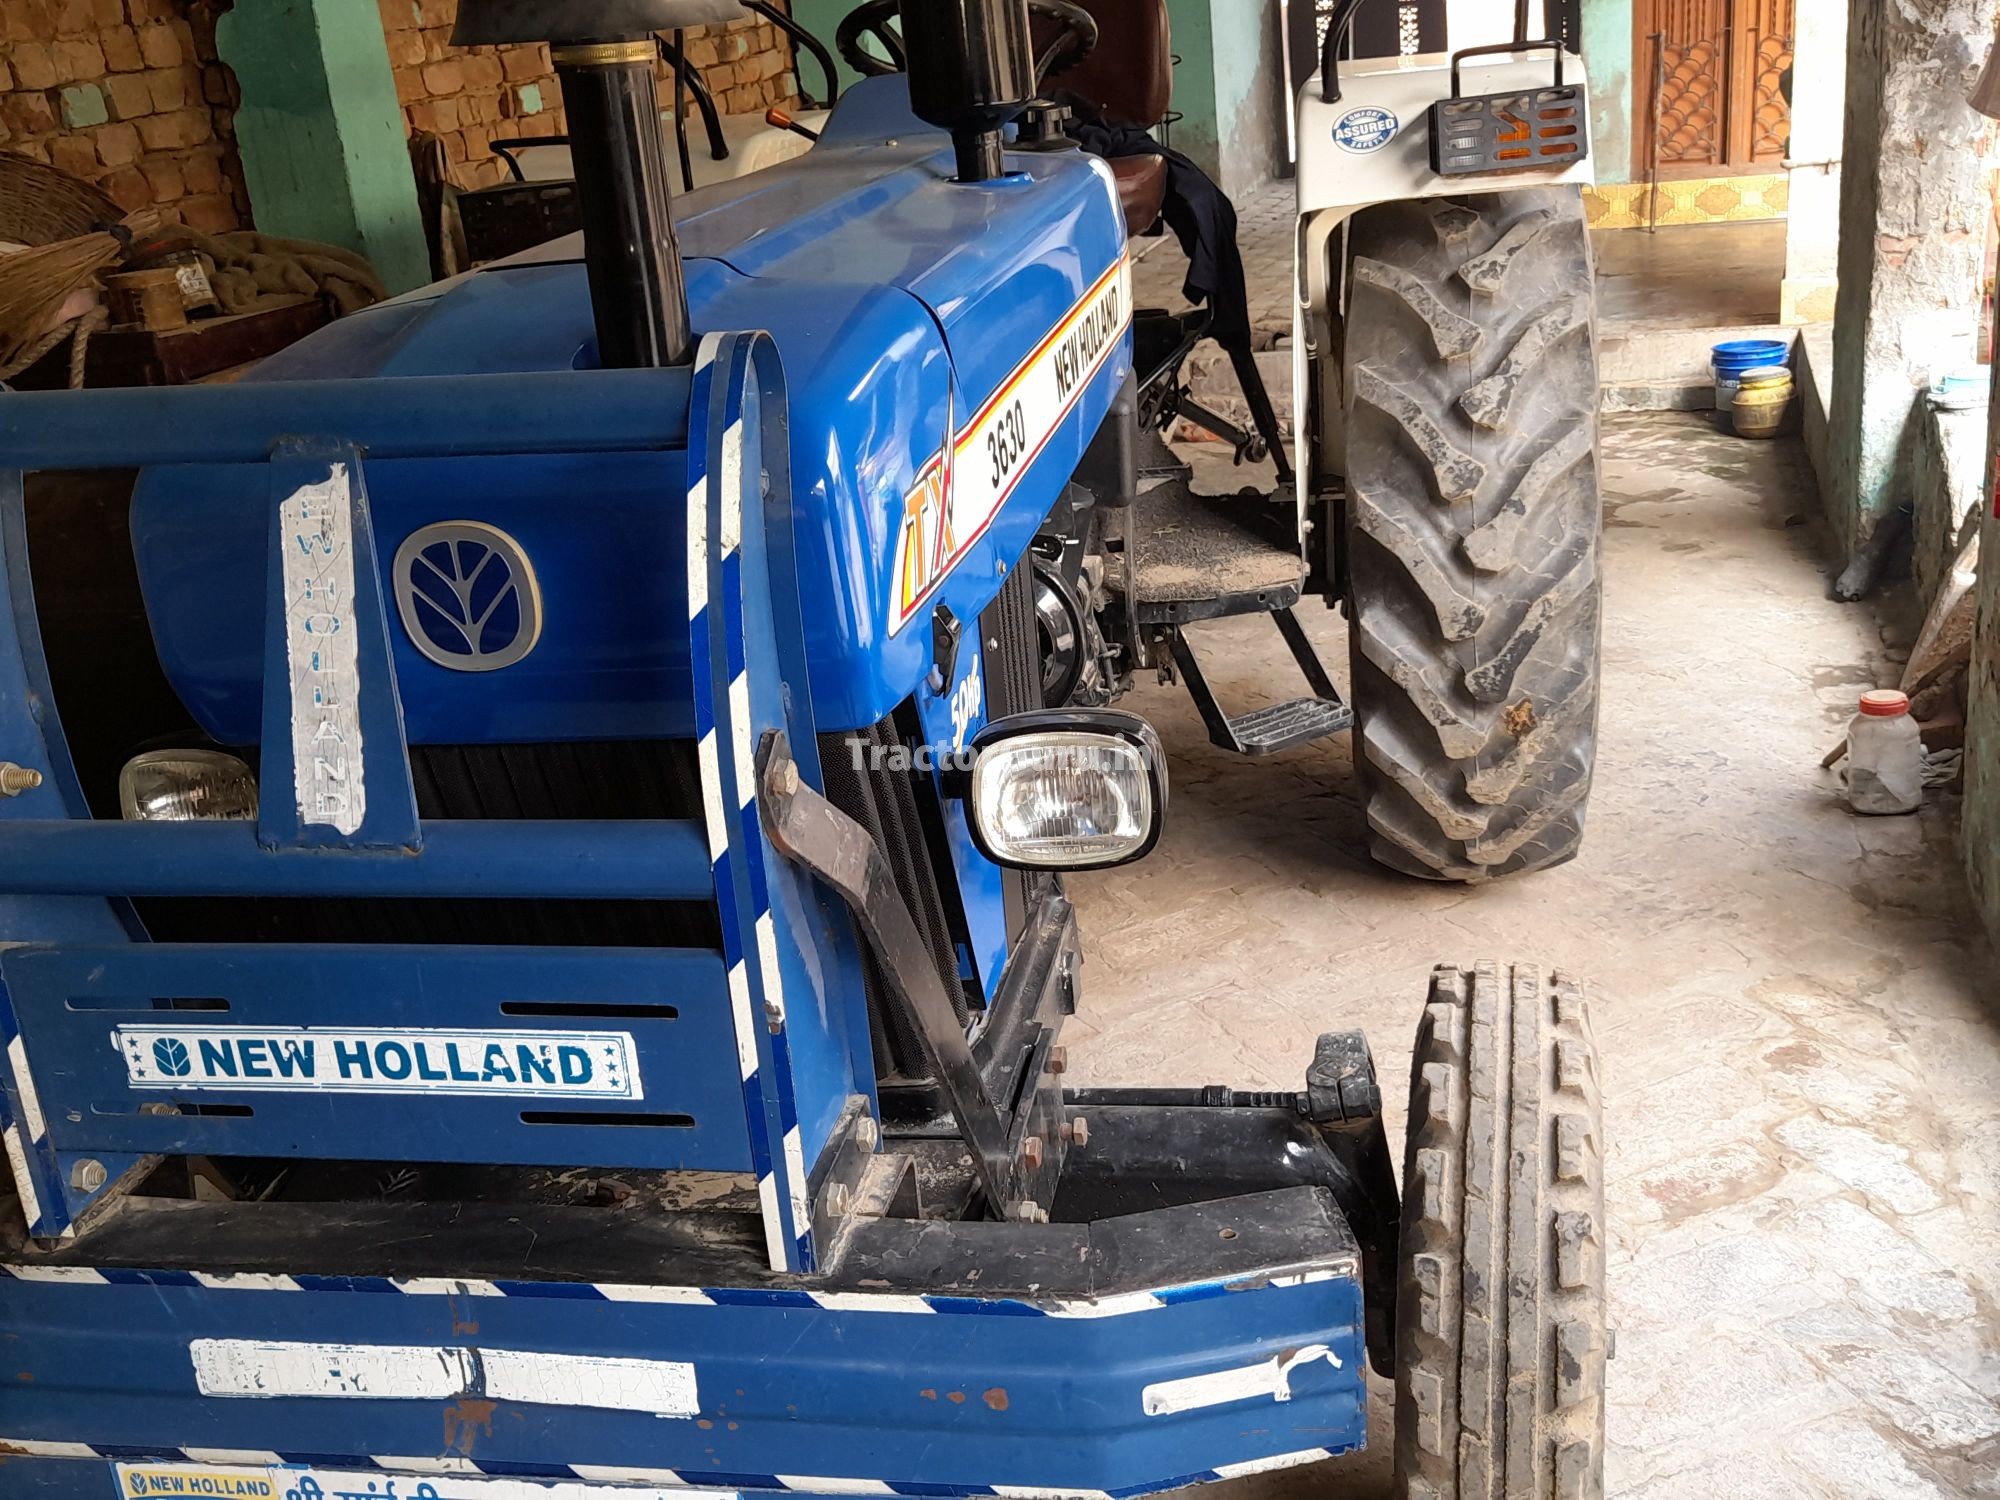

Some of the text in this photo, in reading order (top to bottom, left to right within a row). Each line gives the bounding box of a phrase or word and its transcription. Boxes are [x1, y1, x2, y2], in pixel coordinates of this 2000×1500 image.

[1335, 118, 1396, 140] ASSURED
[1350, 135, 1385, 149] SAFETY
[987, 399, 1026, 489] 3630
[1053, 331, 1080, 403] NEW
[1077, 285, 1118, 371] HOLLAND
[200, 1038, 594, 1085] NEW HOLLAND
[148, 1475, 184, 1492] NEW
[189, 1477, 271, 1497] HOLLAND
